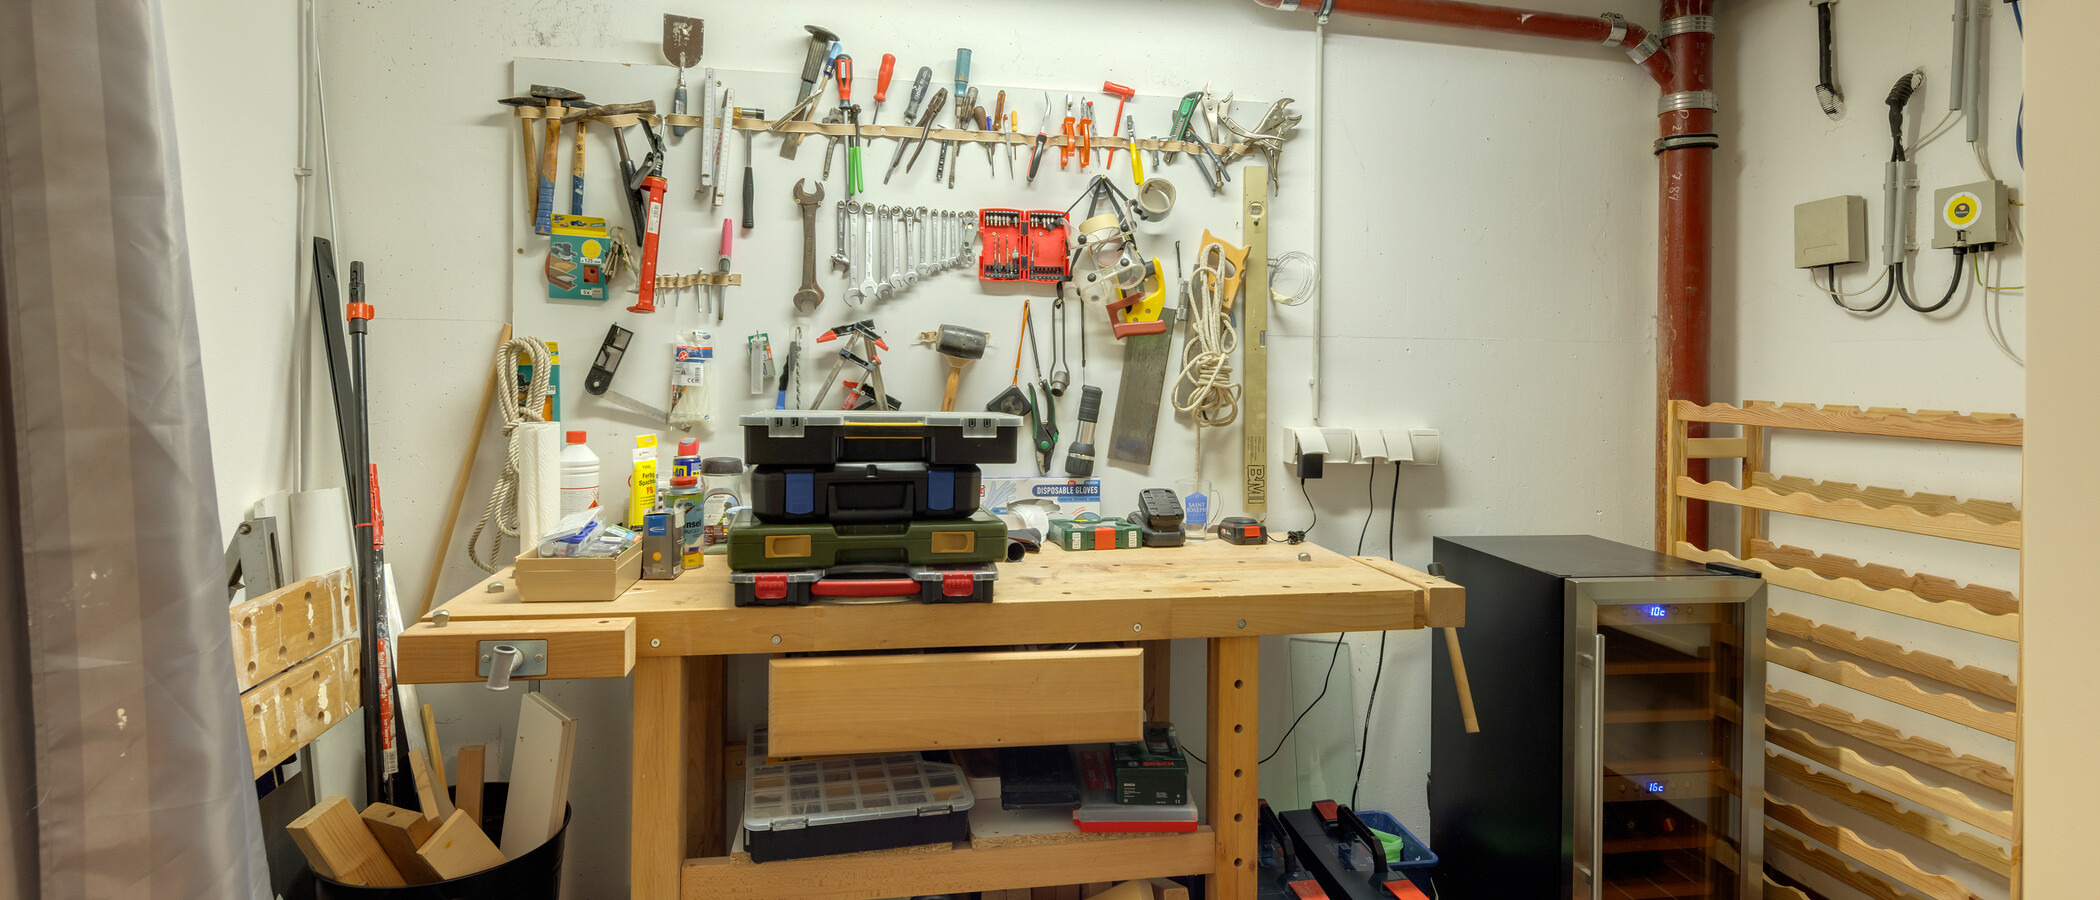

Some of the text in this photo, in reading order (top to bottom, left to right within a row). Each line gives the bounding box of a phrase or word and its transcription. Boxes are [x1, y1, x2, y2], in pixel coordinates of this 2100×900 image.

[1036, 485, 1099, 495] DISPOSABLE GLOVES
[1247, 464, 1265, 505] BMI
